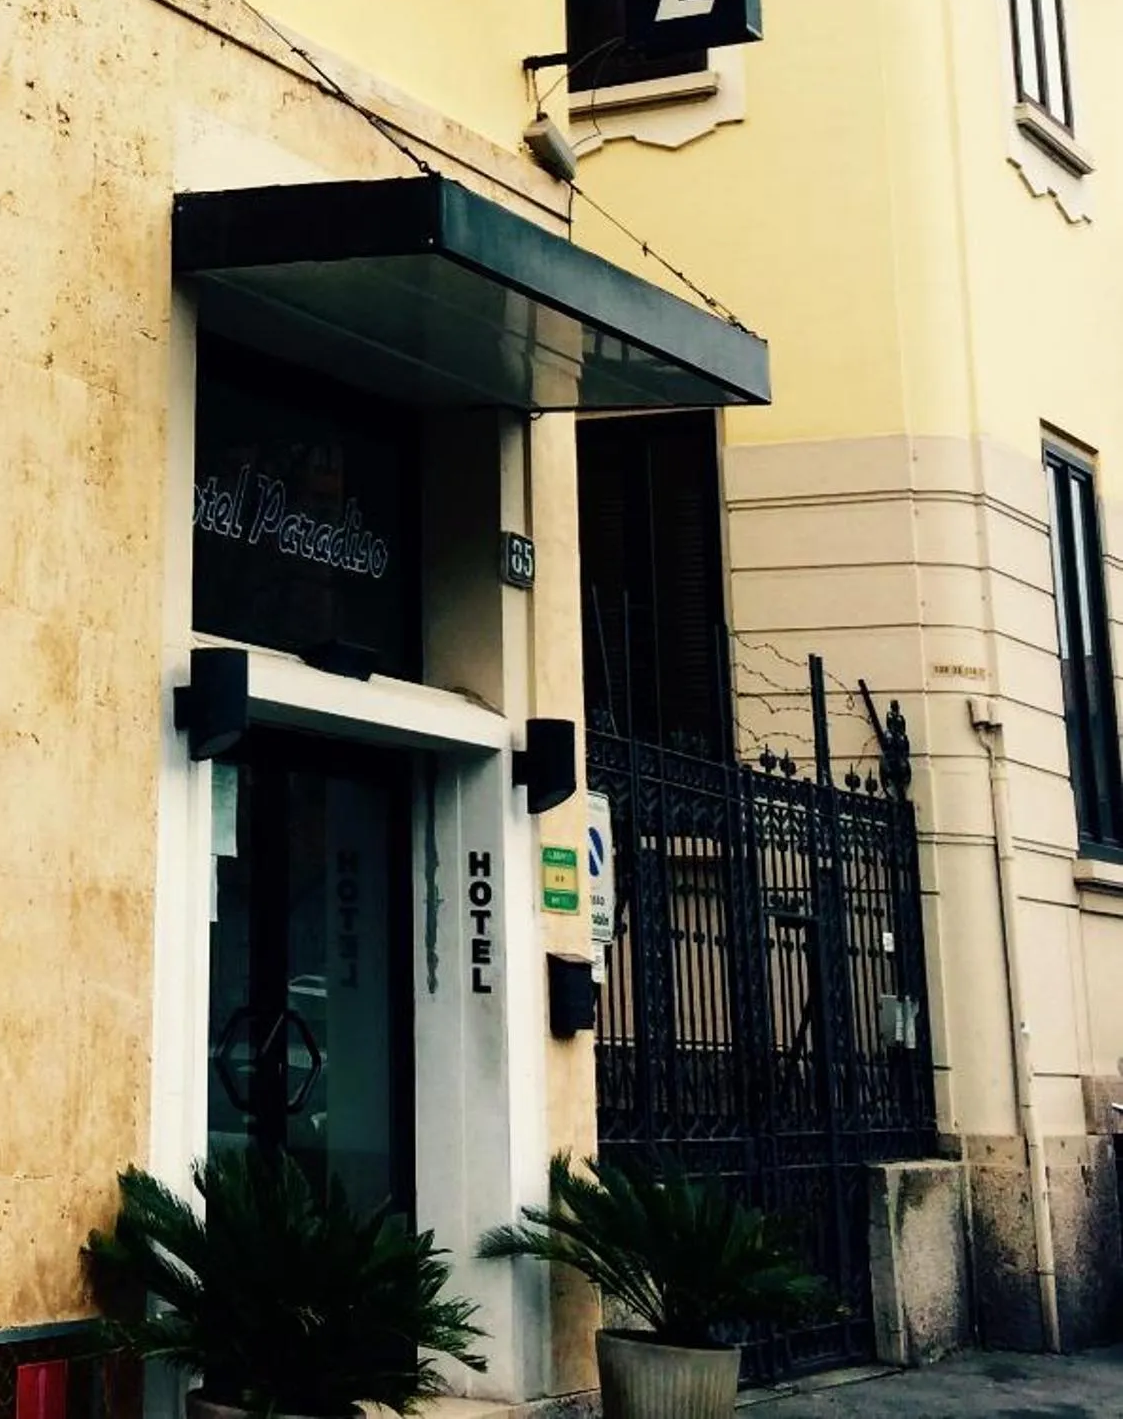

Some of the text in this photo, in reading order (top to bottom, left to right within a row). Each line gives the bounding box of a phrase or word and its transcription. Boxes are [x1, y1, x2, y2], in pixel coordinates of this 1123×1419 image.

[193, 462, 389, 579] tel Paradiso
[469, 852, 492, 993] HOTEL
